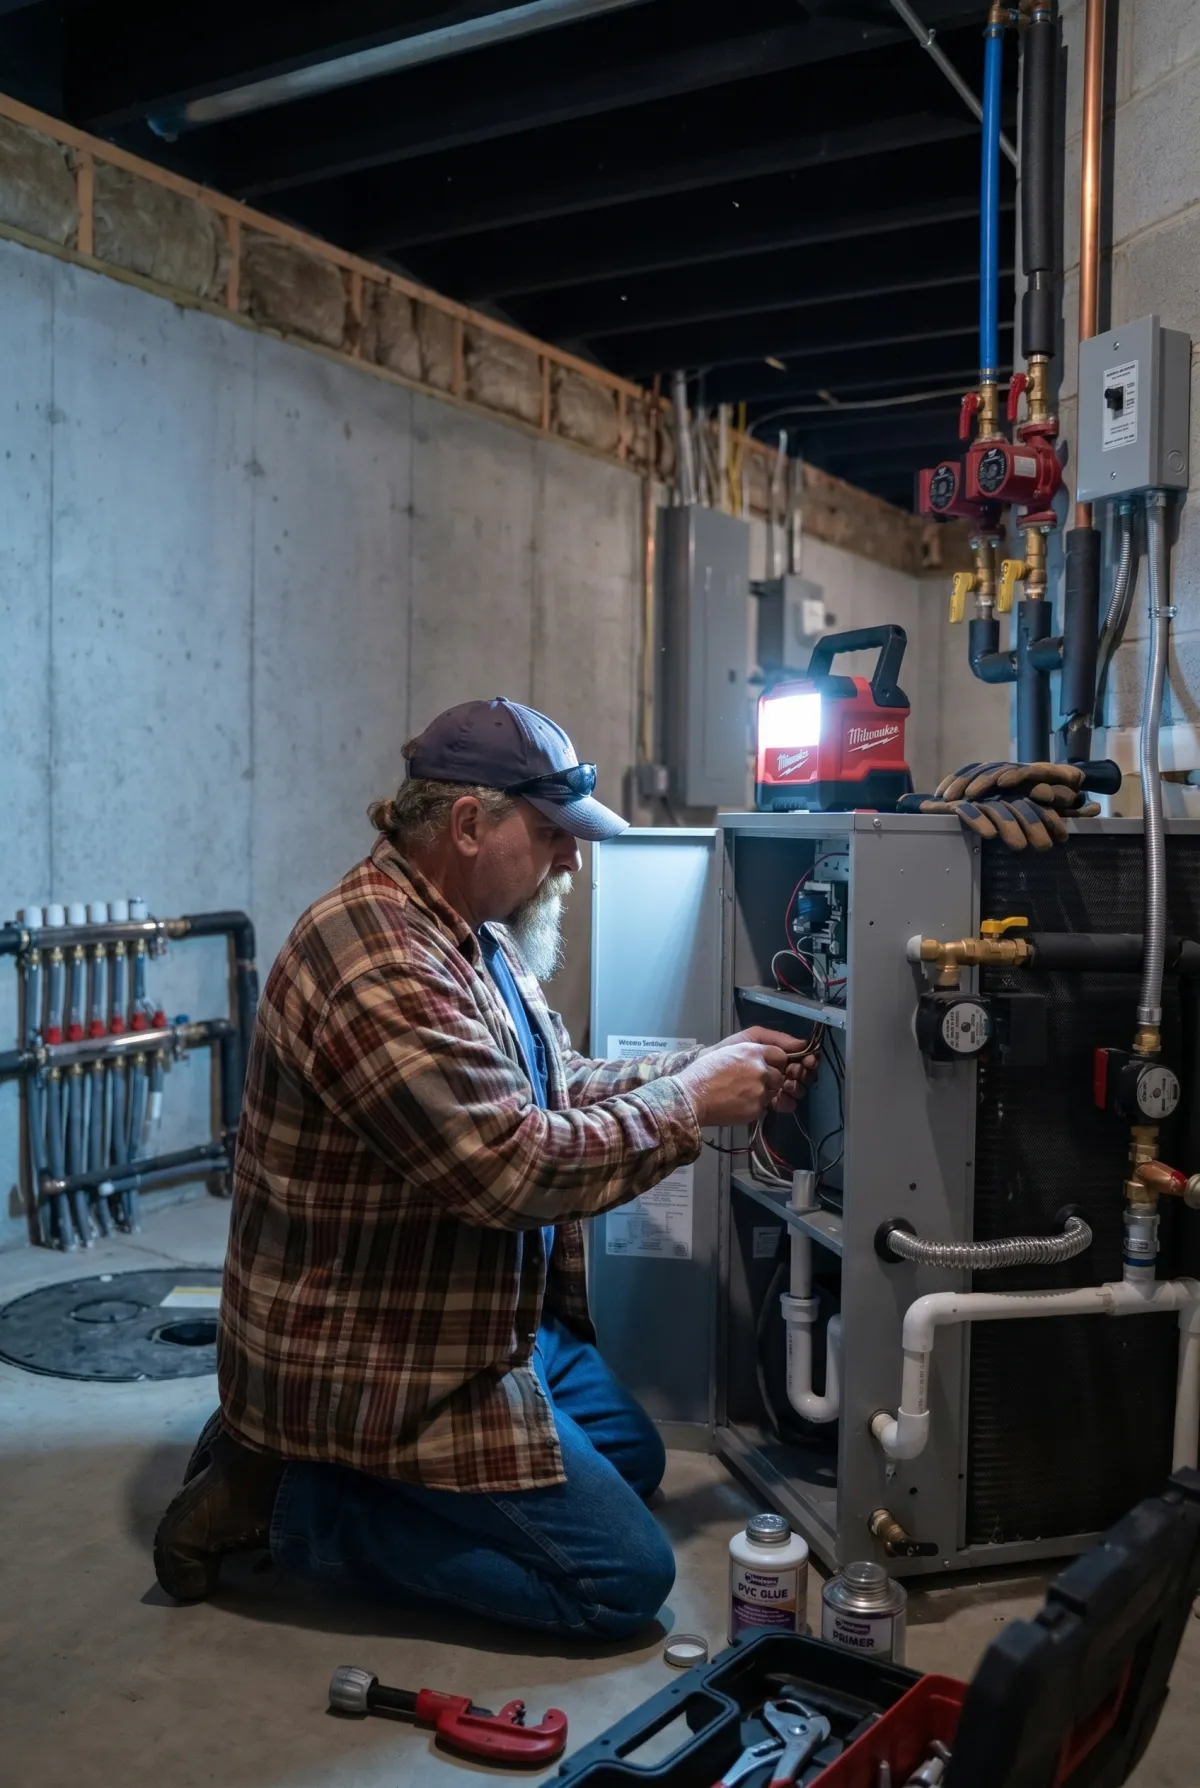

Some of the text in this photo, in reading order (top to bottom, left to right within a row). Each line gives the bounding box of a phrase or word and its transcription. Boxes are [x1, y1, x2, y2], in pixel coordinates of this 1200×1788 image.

[847, 724, 900, 745] Milwaukee
[738, 1583, 757, 1597] PVC
[760, 1589, 788, 1599] GLUE
[832, 1629, 875, 1648] PRIMER
